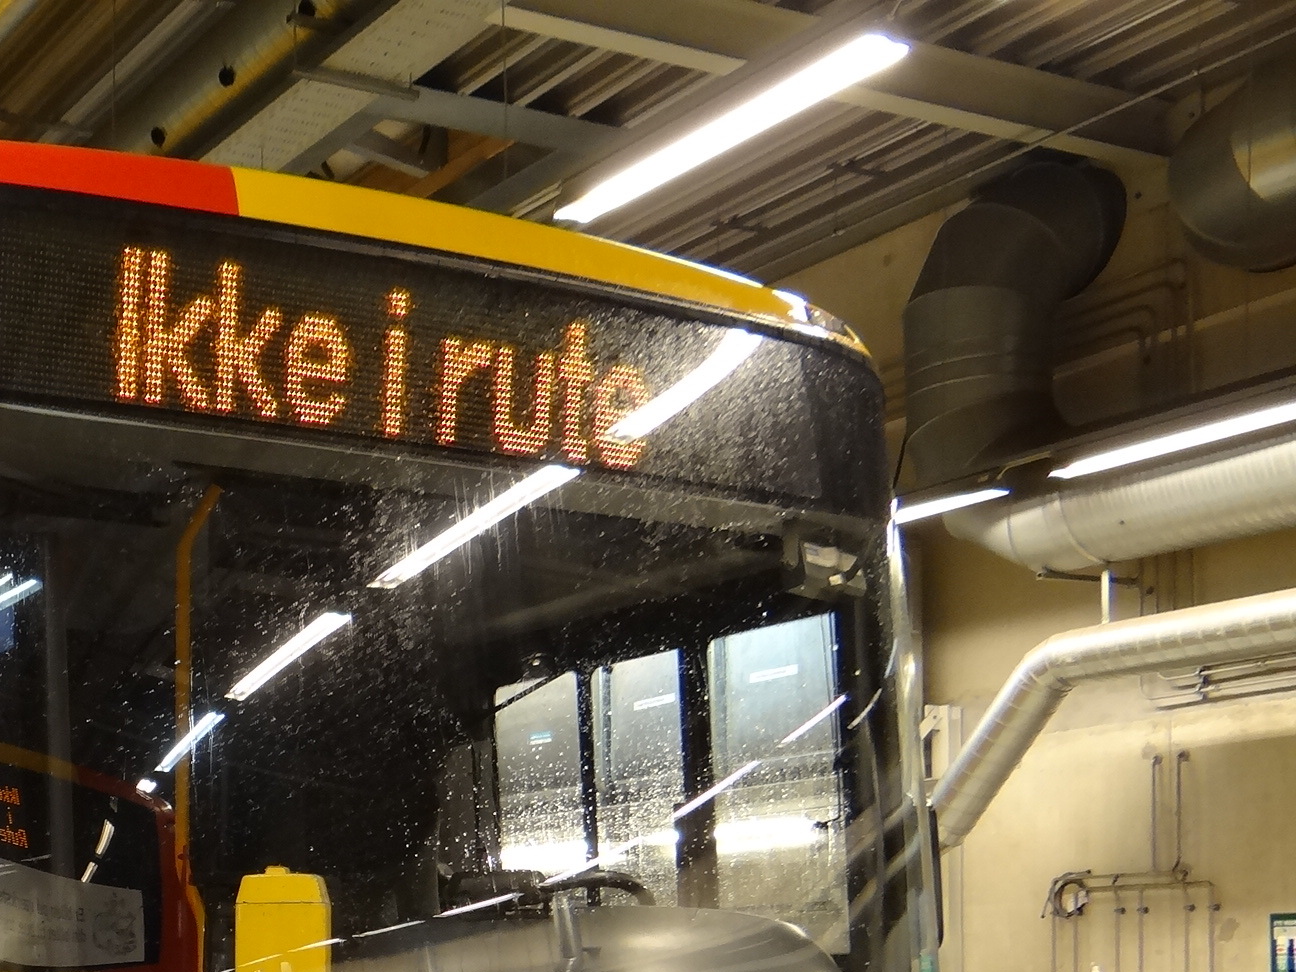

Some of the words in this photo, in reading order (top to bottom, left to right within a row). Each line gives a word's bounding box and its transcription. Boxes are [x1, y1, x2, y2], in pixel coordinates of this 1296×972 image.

[115, 246, 351, 424] Ikke
[382, 286, 410, 439] i
[436, 318, 651, 470] rute
